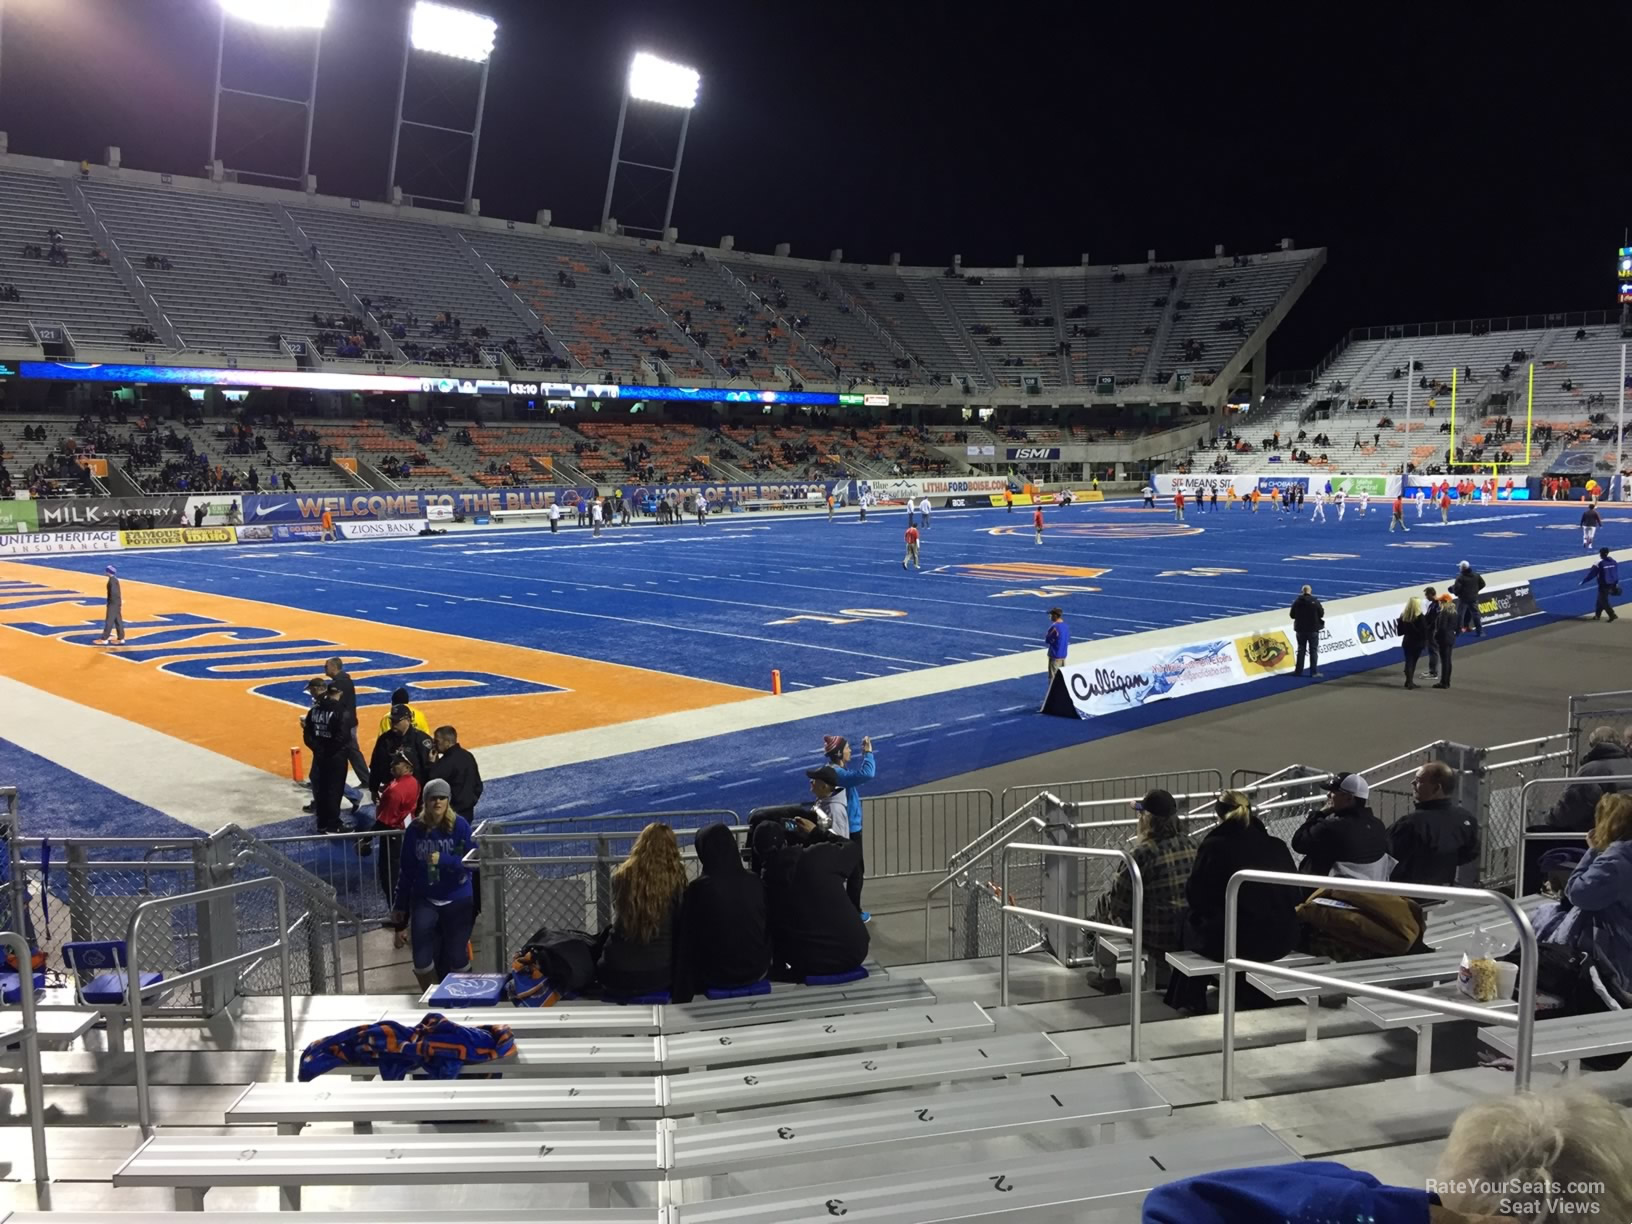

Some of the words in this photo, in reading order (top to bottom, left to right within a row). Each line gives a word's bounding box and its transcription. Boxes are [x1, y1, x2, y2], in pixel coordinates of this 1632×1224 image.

[39, 330, 55, 339] 121
[1015, 448, 1050, 459] ISMI
[1185, 478, 1217, 488] MEANS
[1219, 478, 1232, 488] SIT
[705, 487, 727, 501] OF
[729, 486, 757, 501] THE
[296, 494, 420, 518] WELCOME
[460, 493, 501, 513] THE
[506, 491, 556, 511] BLUE
[43, 506, 101, 524] MILK
[350, 523, 385, 534] ZIONS
[387, 522, 417, 533] BANK
[0, 533, 51, 547] UNITED
[54, 531, 117, 544] HERITAGE
[126, 530, 181, 539] FAMOUS
[186, 533, 229, 542] IDAHO
[126, 537, 182, 545] POTATOES
[11, 542, 110, 553] INSURANCE
[1071, 668, 1150, 703] Culligan
